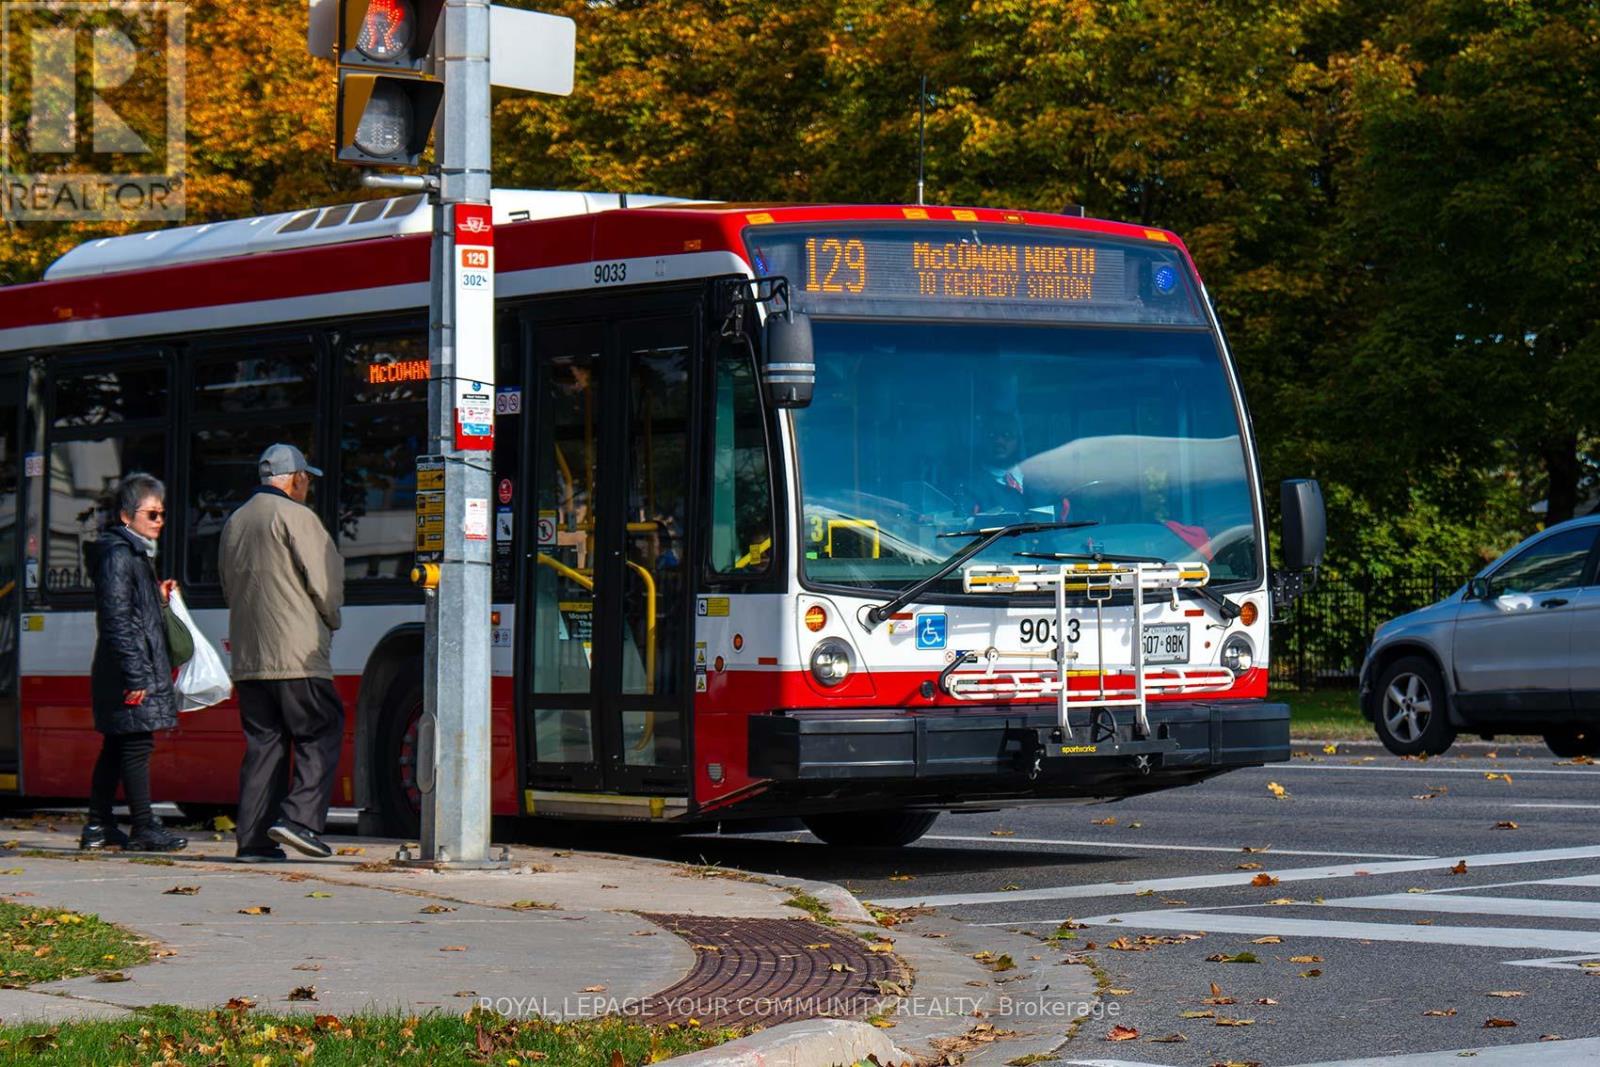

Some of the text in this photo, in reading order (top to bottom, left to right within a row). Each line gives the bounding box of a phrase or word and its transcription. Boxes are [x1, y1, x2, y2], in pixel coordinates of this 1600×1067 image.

[467, 253, 486, 265] 129
[805, 238, 866, 293] 129
[912, 242, 1096, 274] McCOWAN NORTH
[463, 274, 482, 286] 302
[594, 262, 627, 284] 9033
[918, 271, 1093, 299] TO KENNEDY STATION
